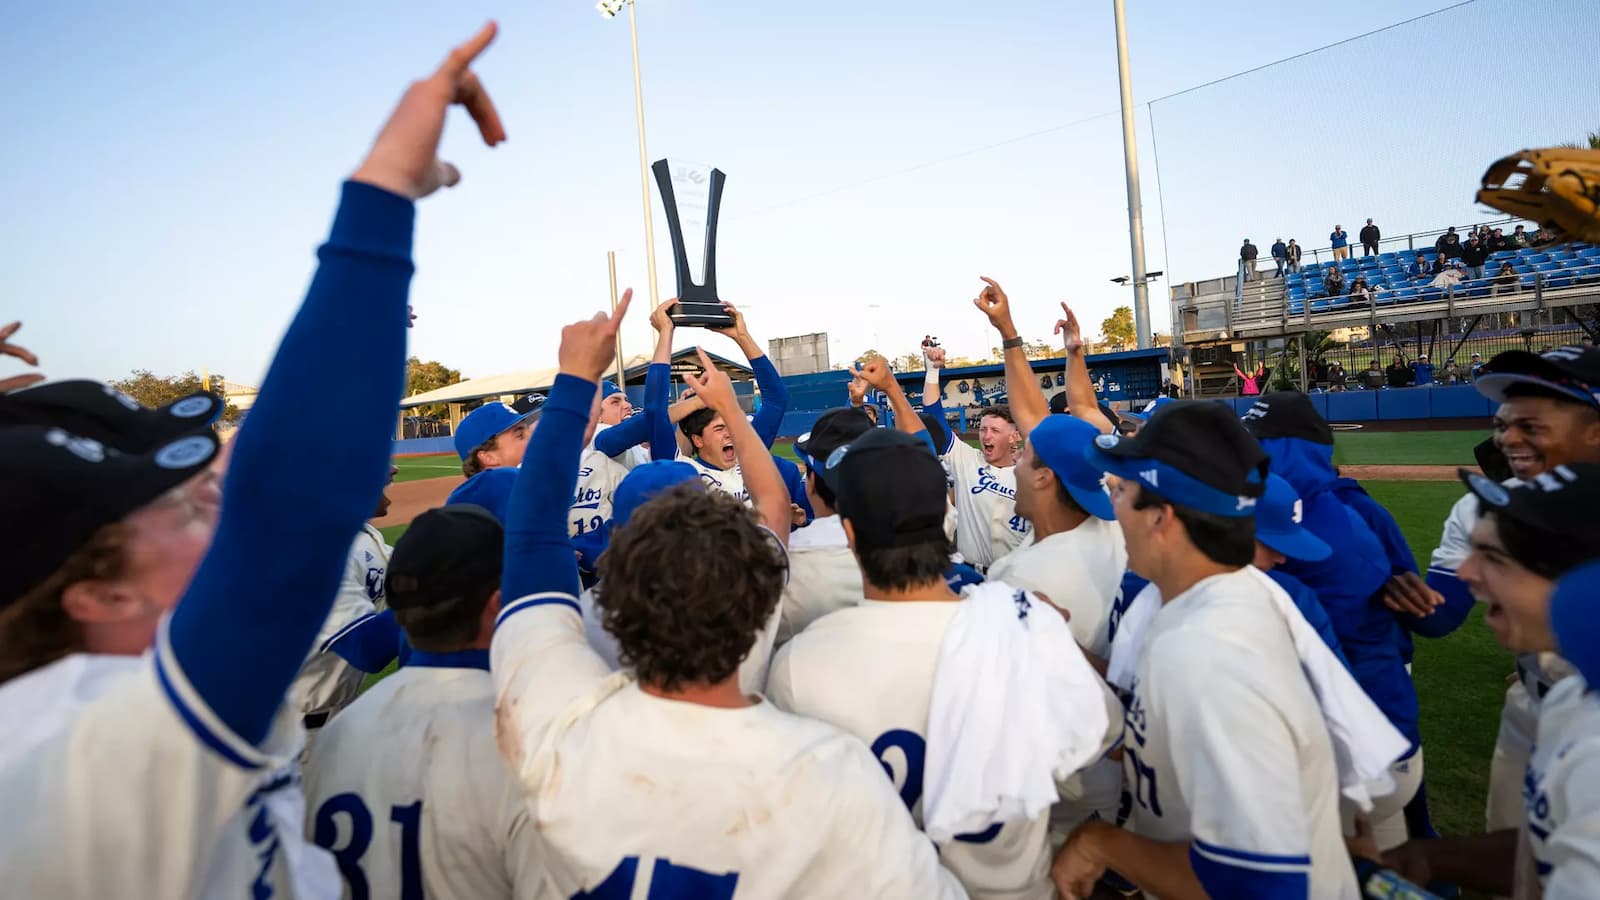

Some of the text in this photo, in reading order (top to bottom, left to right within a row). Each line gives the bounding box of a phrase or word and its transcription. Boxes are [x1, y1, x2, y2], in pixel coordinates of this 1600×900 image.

[971, 466, 1017, 496] Gauc
[1008, 514, 1027, 533] 41
[314, 792, 425, 900] 31
